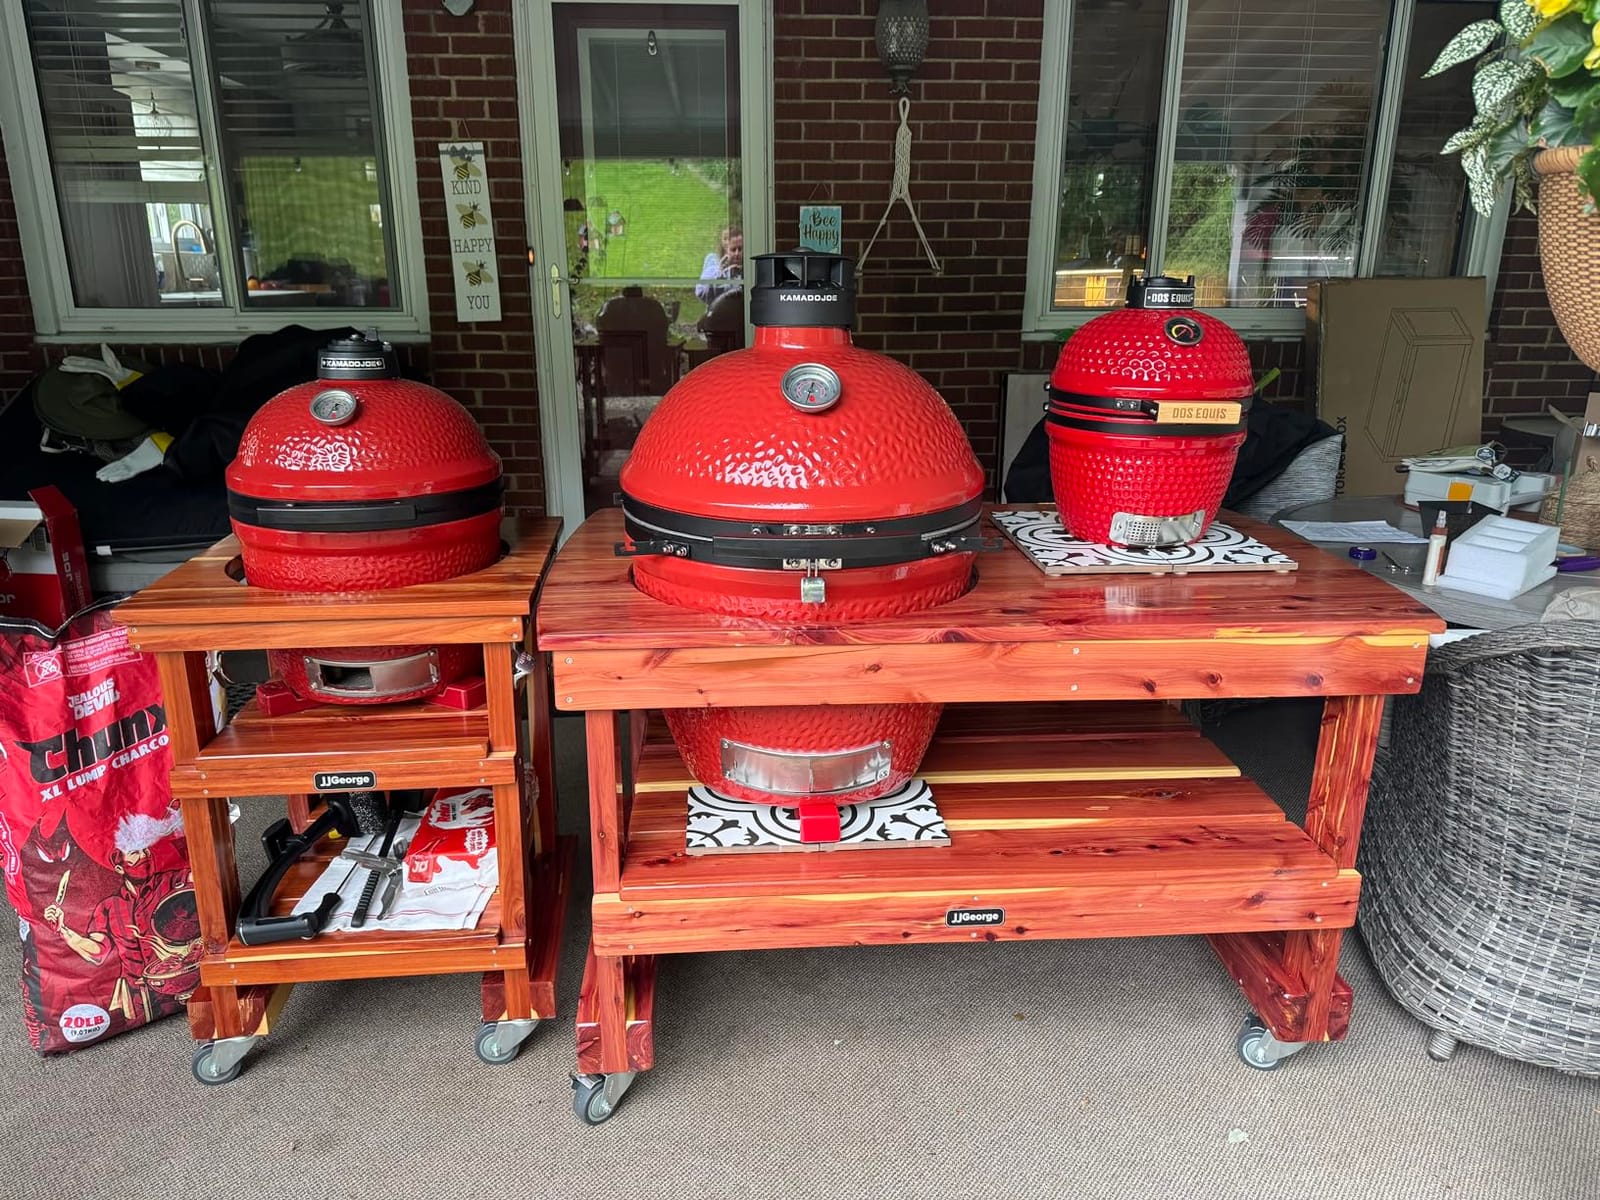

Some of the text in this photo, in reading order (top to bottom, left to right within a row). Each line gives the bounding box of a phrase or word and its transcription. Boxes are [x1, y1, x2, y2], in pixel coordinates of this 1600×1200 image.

[451, 180, 482, 195] KIND
[810, 208, 836, 226] Bee
[803, 223, 839, 246] Happy
[453, 238, 493, 253] HAPPY
[467, 295, 490, 310] YOU
[780, 294, 838, 302] KAMADOJOE
[1151, 293, 1170, 303] DOS
[326, 360, 377, 368] KAMADOJOE
[1172, 407, 1227, 420] DOS EQUIS
[66, 678, 115, 708] JEALOUS
[74, 688, 120, 720] DEVIL
[40, 784, 63, 802] XL
[66, 764, 107, 791] LUMP
[320, 775, 370, 787] JJGeorge
[951, 912, 999, 924] JJGeorge
[64, 1015, 105, 1028] 20LB
